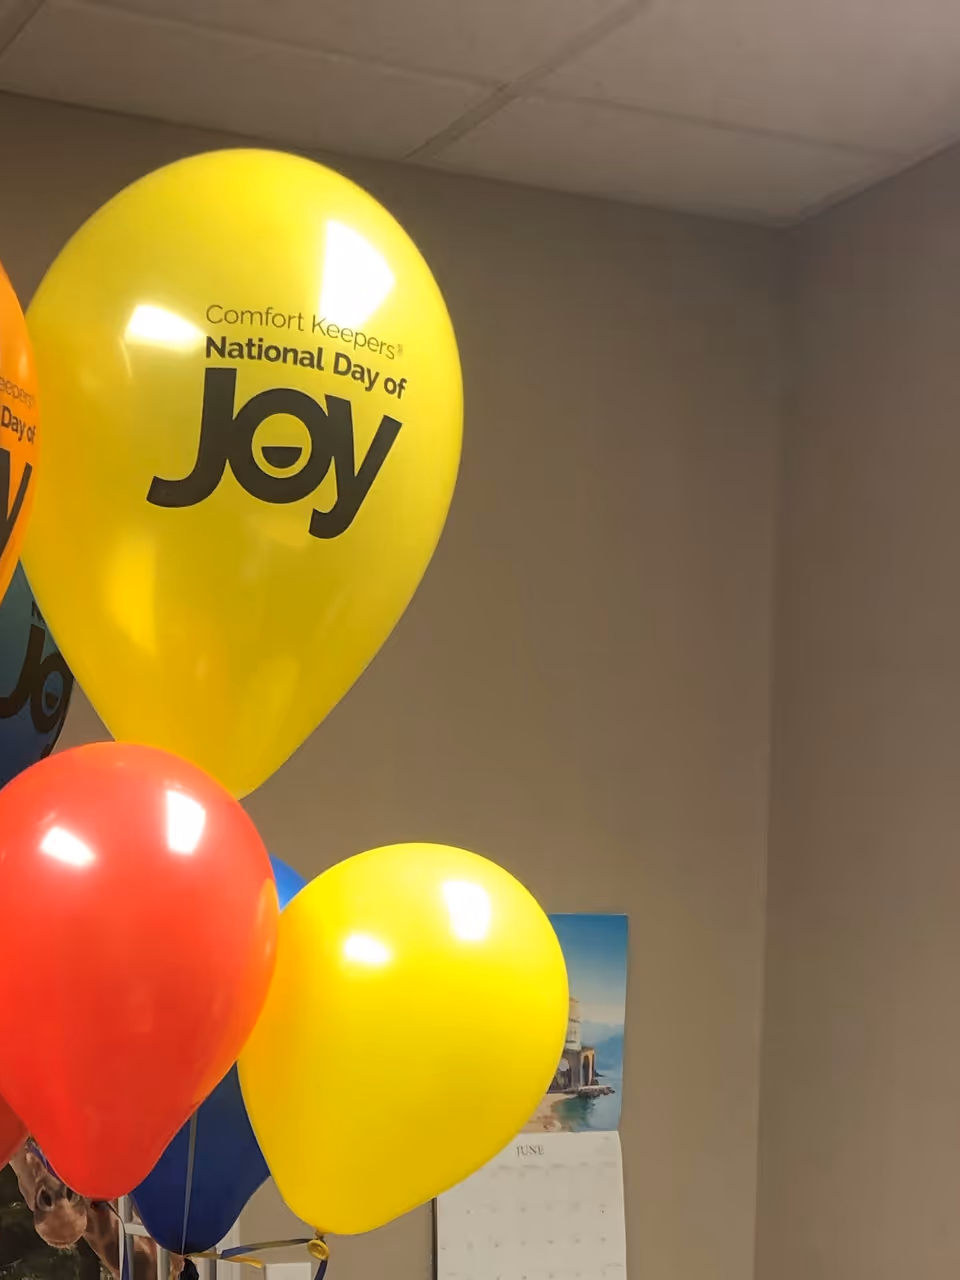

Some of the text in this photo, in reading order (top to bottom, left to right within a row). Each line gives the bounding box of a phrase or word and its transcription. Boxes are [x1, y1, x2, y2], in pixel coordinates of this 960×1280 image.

[206, 304, 304, 331] Comfort
[205, 335, 407, 399] National Day of
[1, 405, 26, 442] Day
[27, 425, 36, 444] of
[516, 1145, 544, 1157] JUNE
